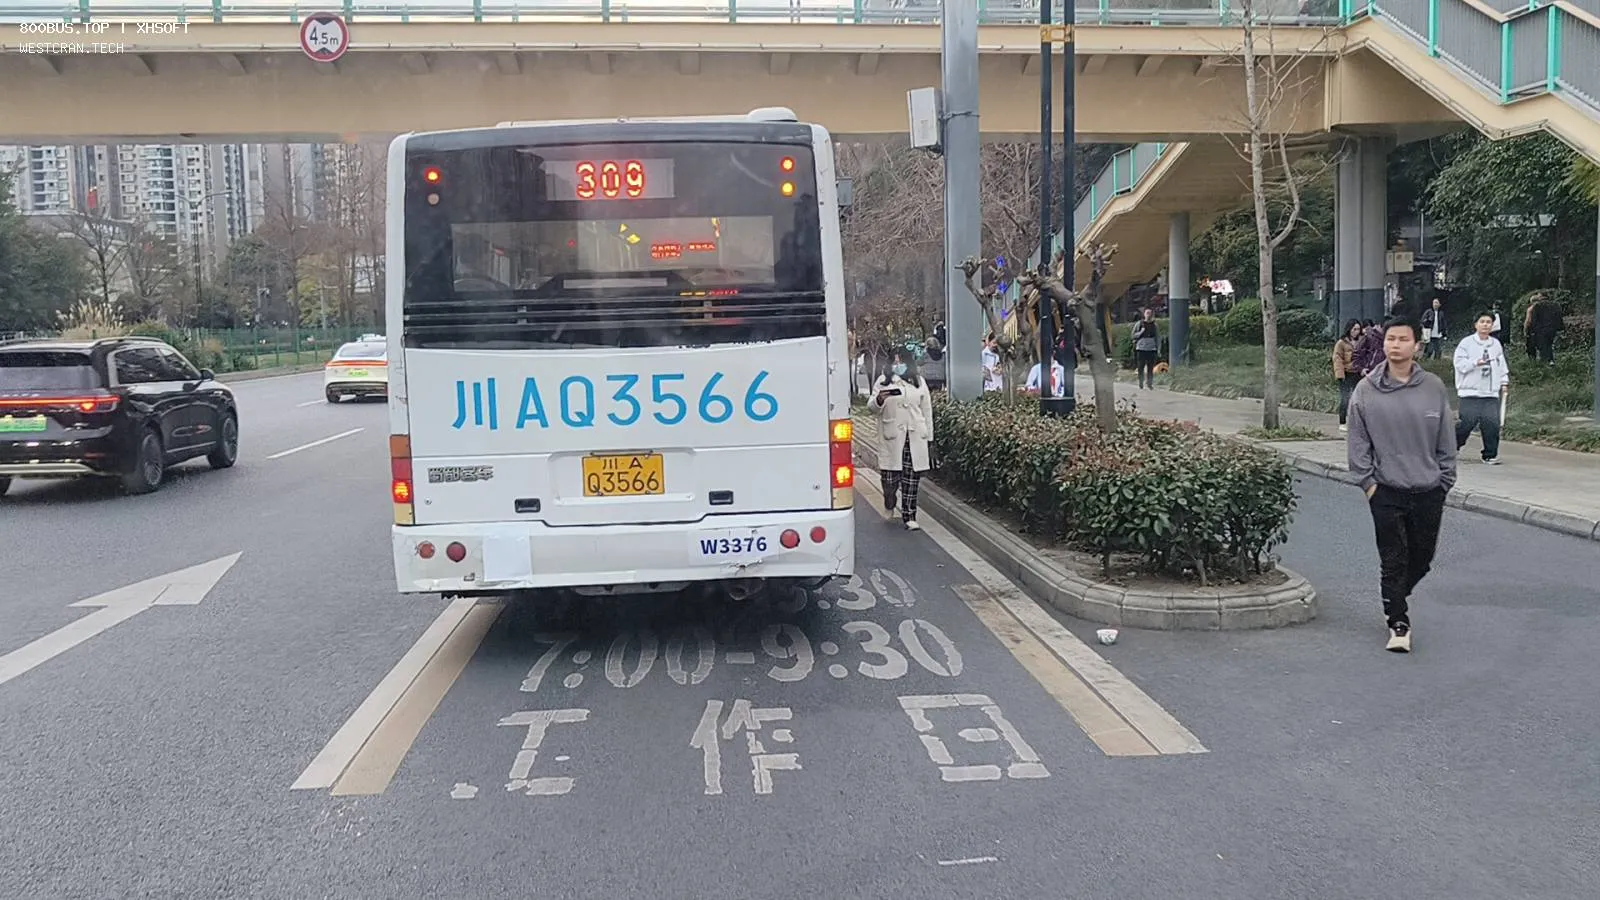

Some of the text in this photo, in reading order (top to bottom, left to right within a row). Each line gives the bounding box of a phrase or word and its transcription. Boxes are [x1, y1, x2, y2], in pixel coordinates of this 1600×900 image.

[575, 160, 645, 199] 309
[587, 471, 660, 494] Q3566
[700, 536, 768, 555] W3376
[520, 618, 964, 692] 7:00-9:30
